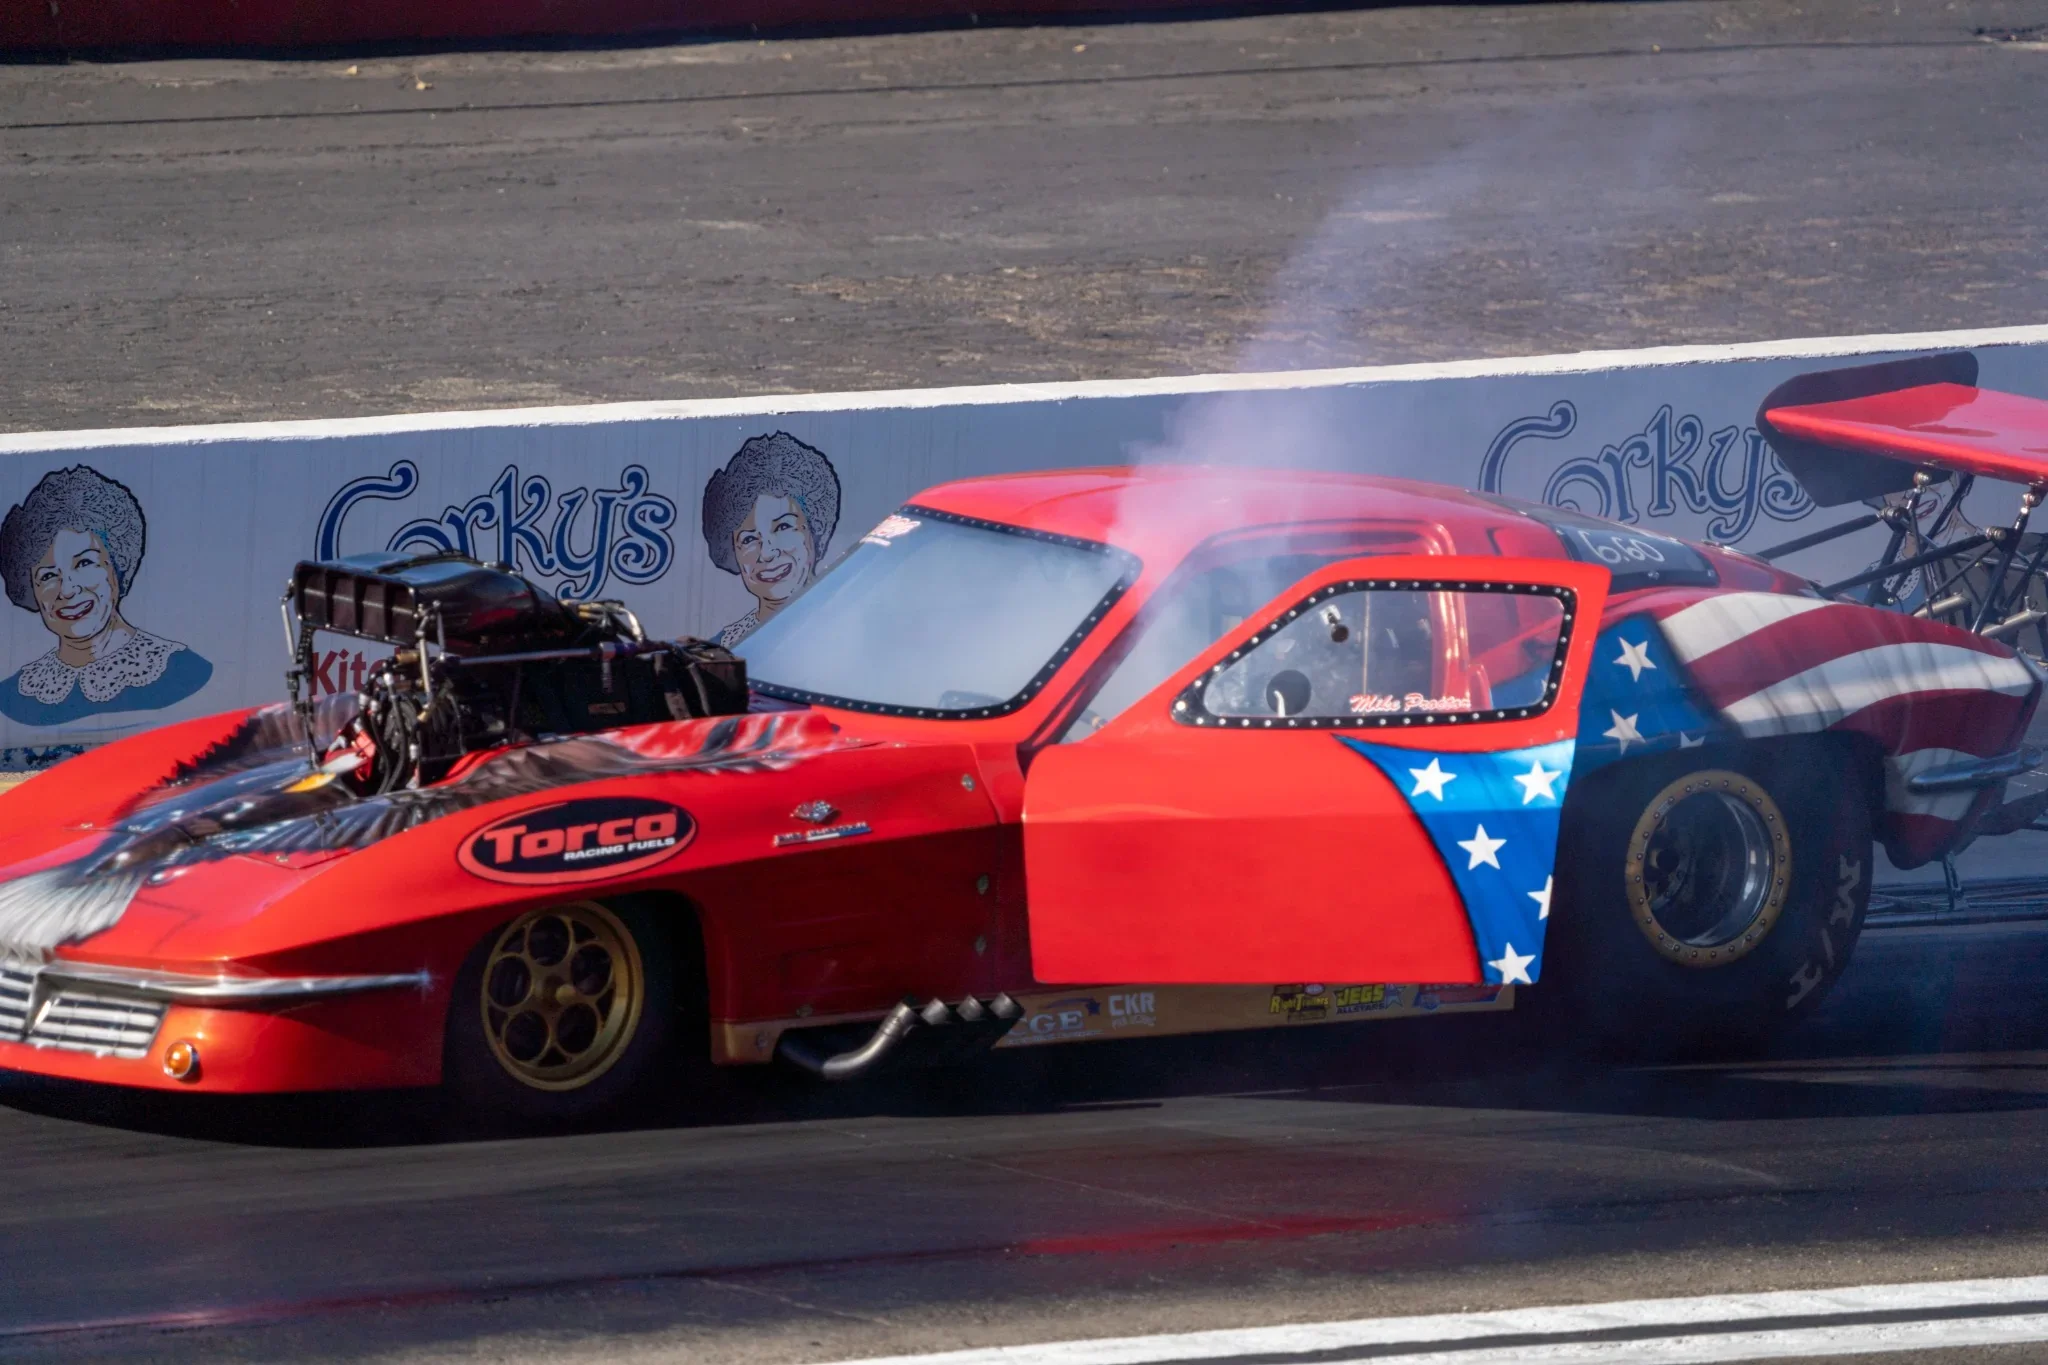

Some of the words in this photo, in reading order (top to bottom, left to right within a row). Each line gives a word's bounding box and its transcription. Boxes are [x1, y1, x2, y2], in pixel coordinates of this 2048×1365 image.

[1478, 400, 1817, 545] Corkys
[1349, 693, 1401, 712] Mike
[483, 812, 678, 864] Torco
[563, 844, 625, 861] RACING
[627, 836, 677, 852] FUELS
[1108, 991, 1156, 1016] CKR
[1336, 984, 1385, 1007] JEGS
